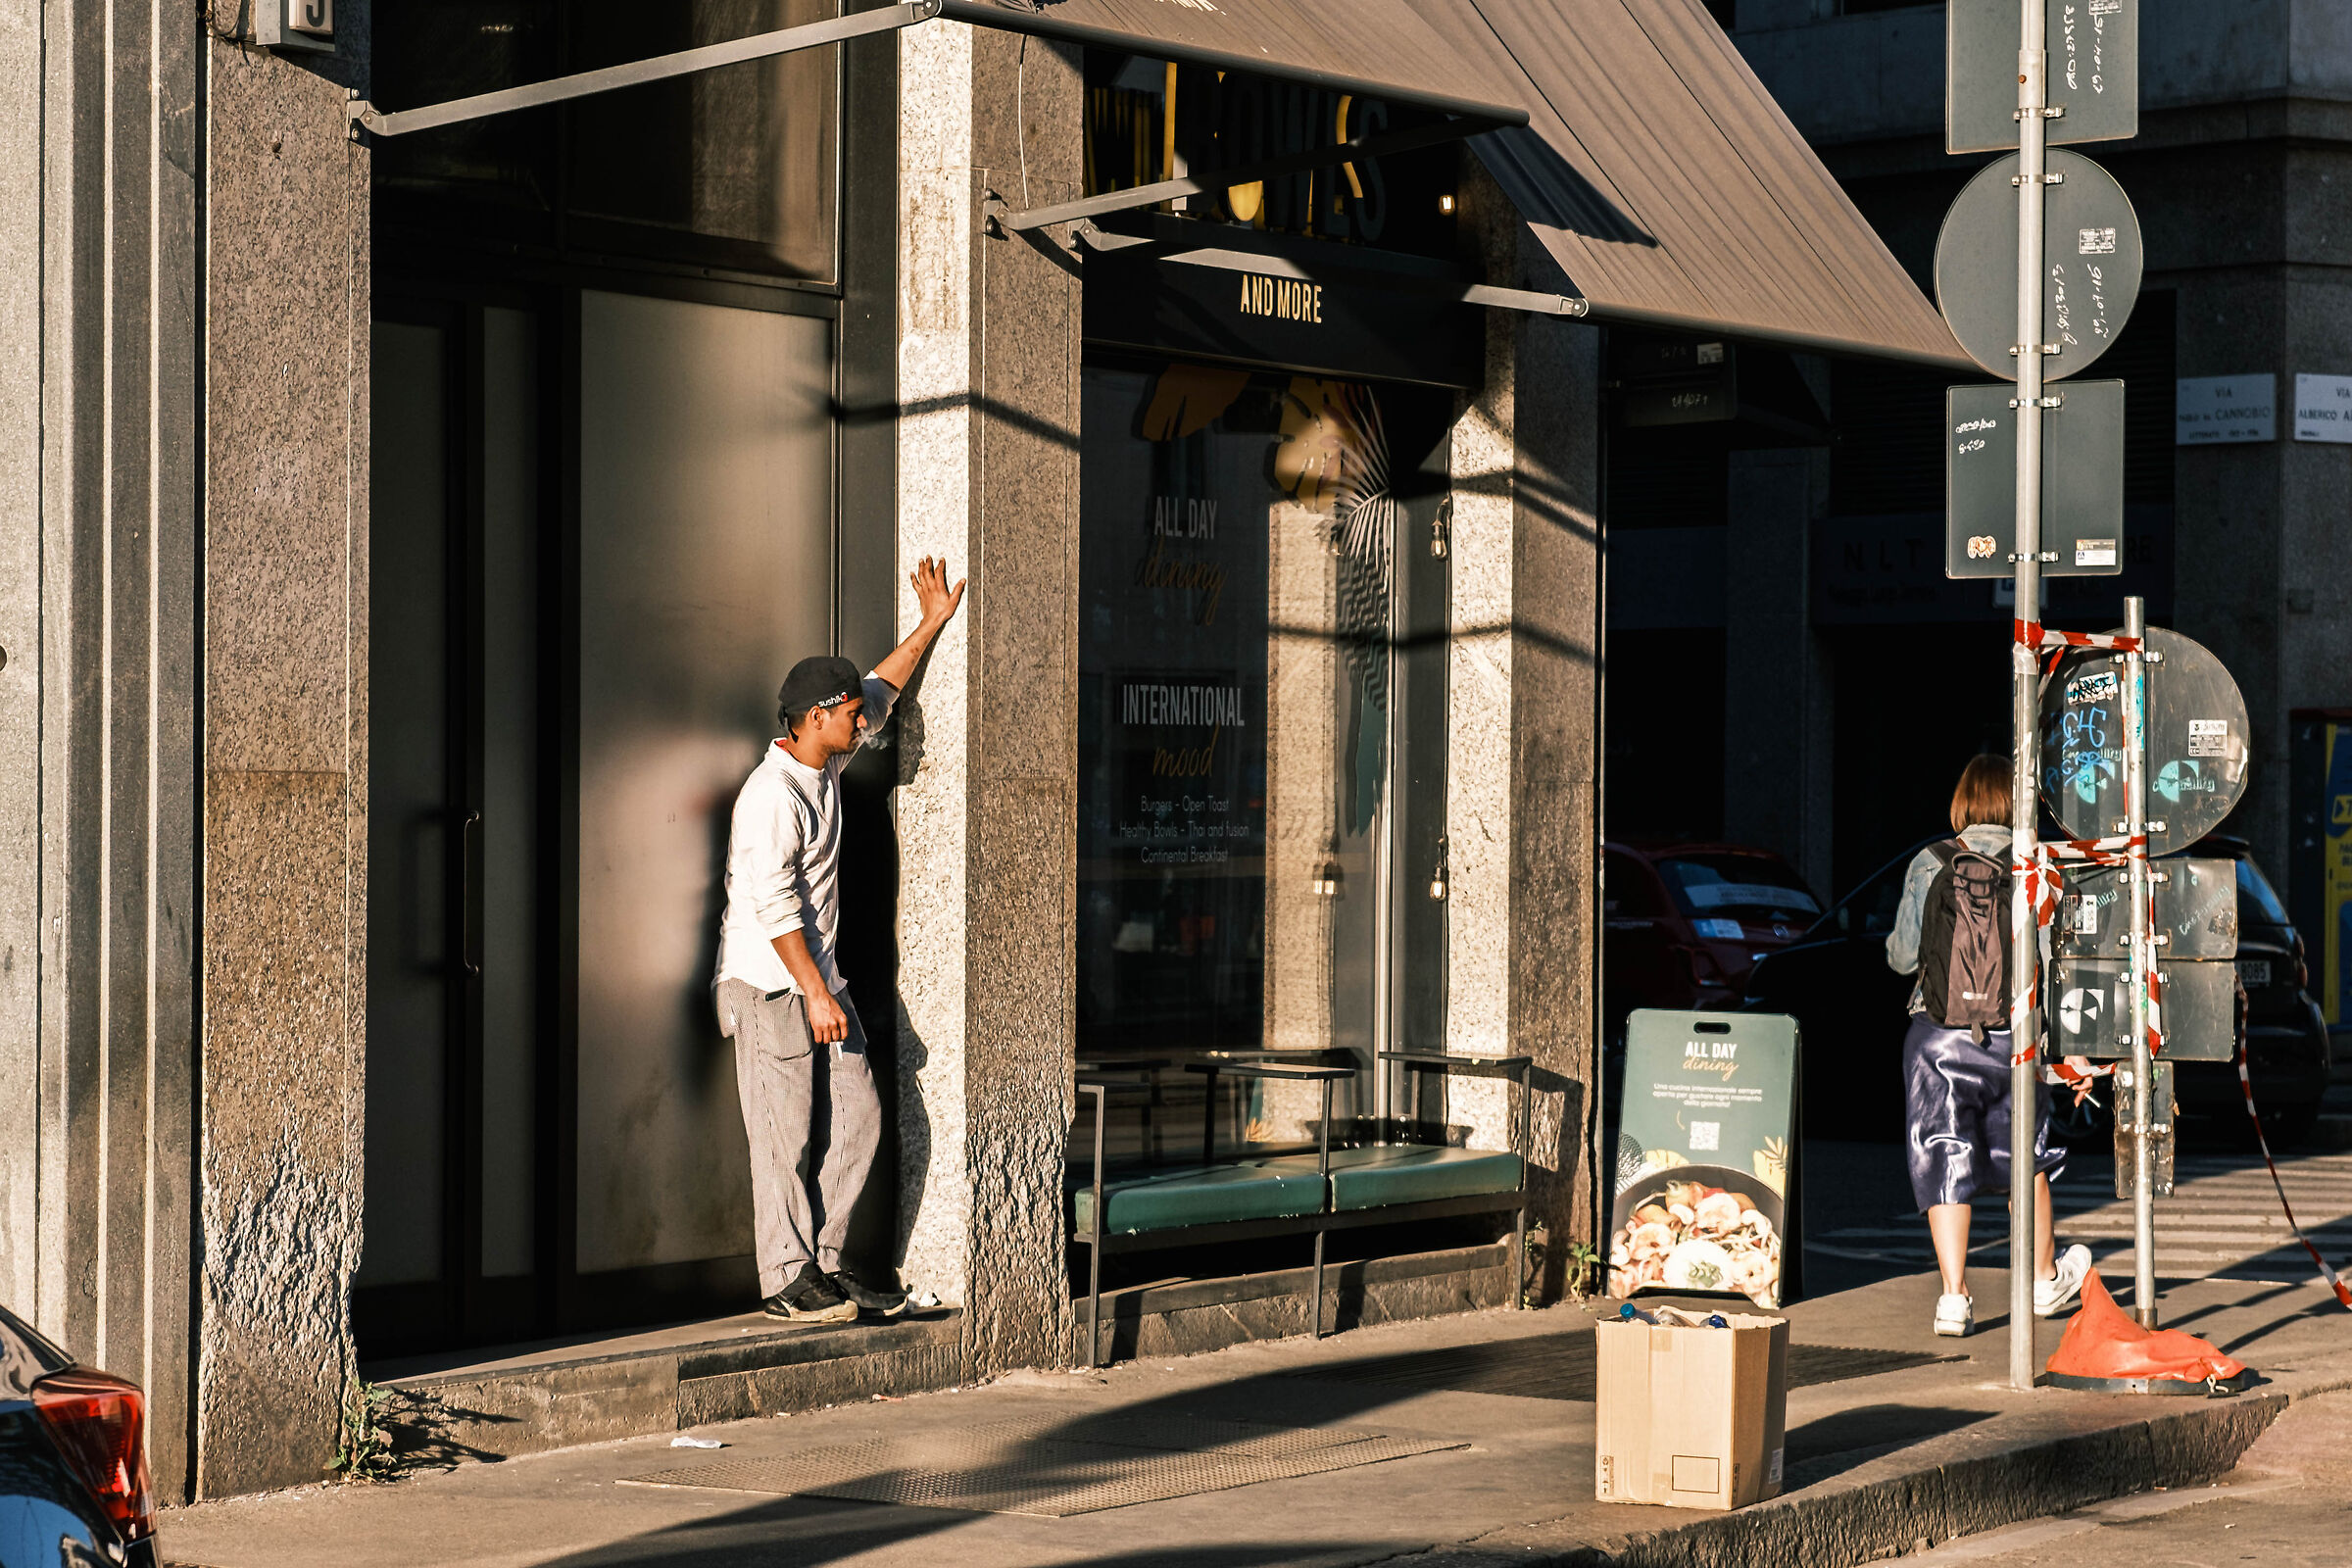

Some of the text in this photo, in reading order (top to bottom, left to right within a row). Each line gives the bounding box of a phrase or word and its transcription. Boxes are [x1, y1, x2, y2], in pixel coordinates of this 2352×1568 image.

[1240, 273, 1322, 324] AND MORE
[2215, 387, 2232, 398] VIA
[2336, 388, 2351, 398] VIA
[2215, 406, 2271, 421] CANNOBIO
[2298, 409, 2337, 422] ALBERICO
[1153, 495, 1218, 541] ALL DAY
[1144, 536, 1228, 626] dining
[1122, 684, 1246, 727] INTERNATIONAL
[1152, 722, 1221, 777] mood
[1140, 796, 1172, 815] Burgers
[1182, 796, 1205, 816] Open
[1208, 796, 1231, 812] Toast
[1119, 820, 1152, 840] Healthy
[1153, 821, 1178, 839] Bowls
[1188, 821, 1204, 839] Thai
[1207, 822, 1224, 838] and
[1226, 822, 1250, 839] fusion
[1140, 846, 1230, 864] Continental Breakfast
[1685, 1041, 1738, 1059] ALL DAY
[1683, 1054, 1740, 1082] dining
